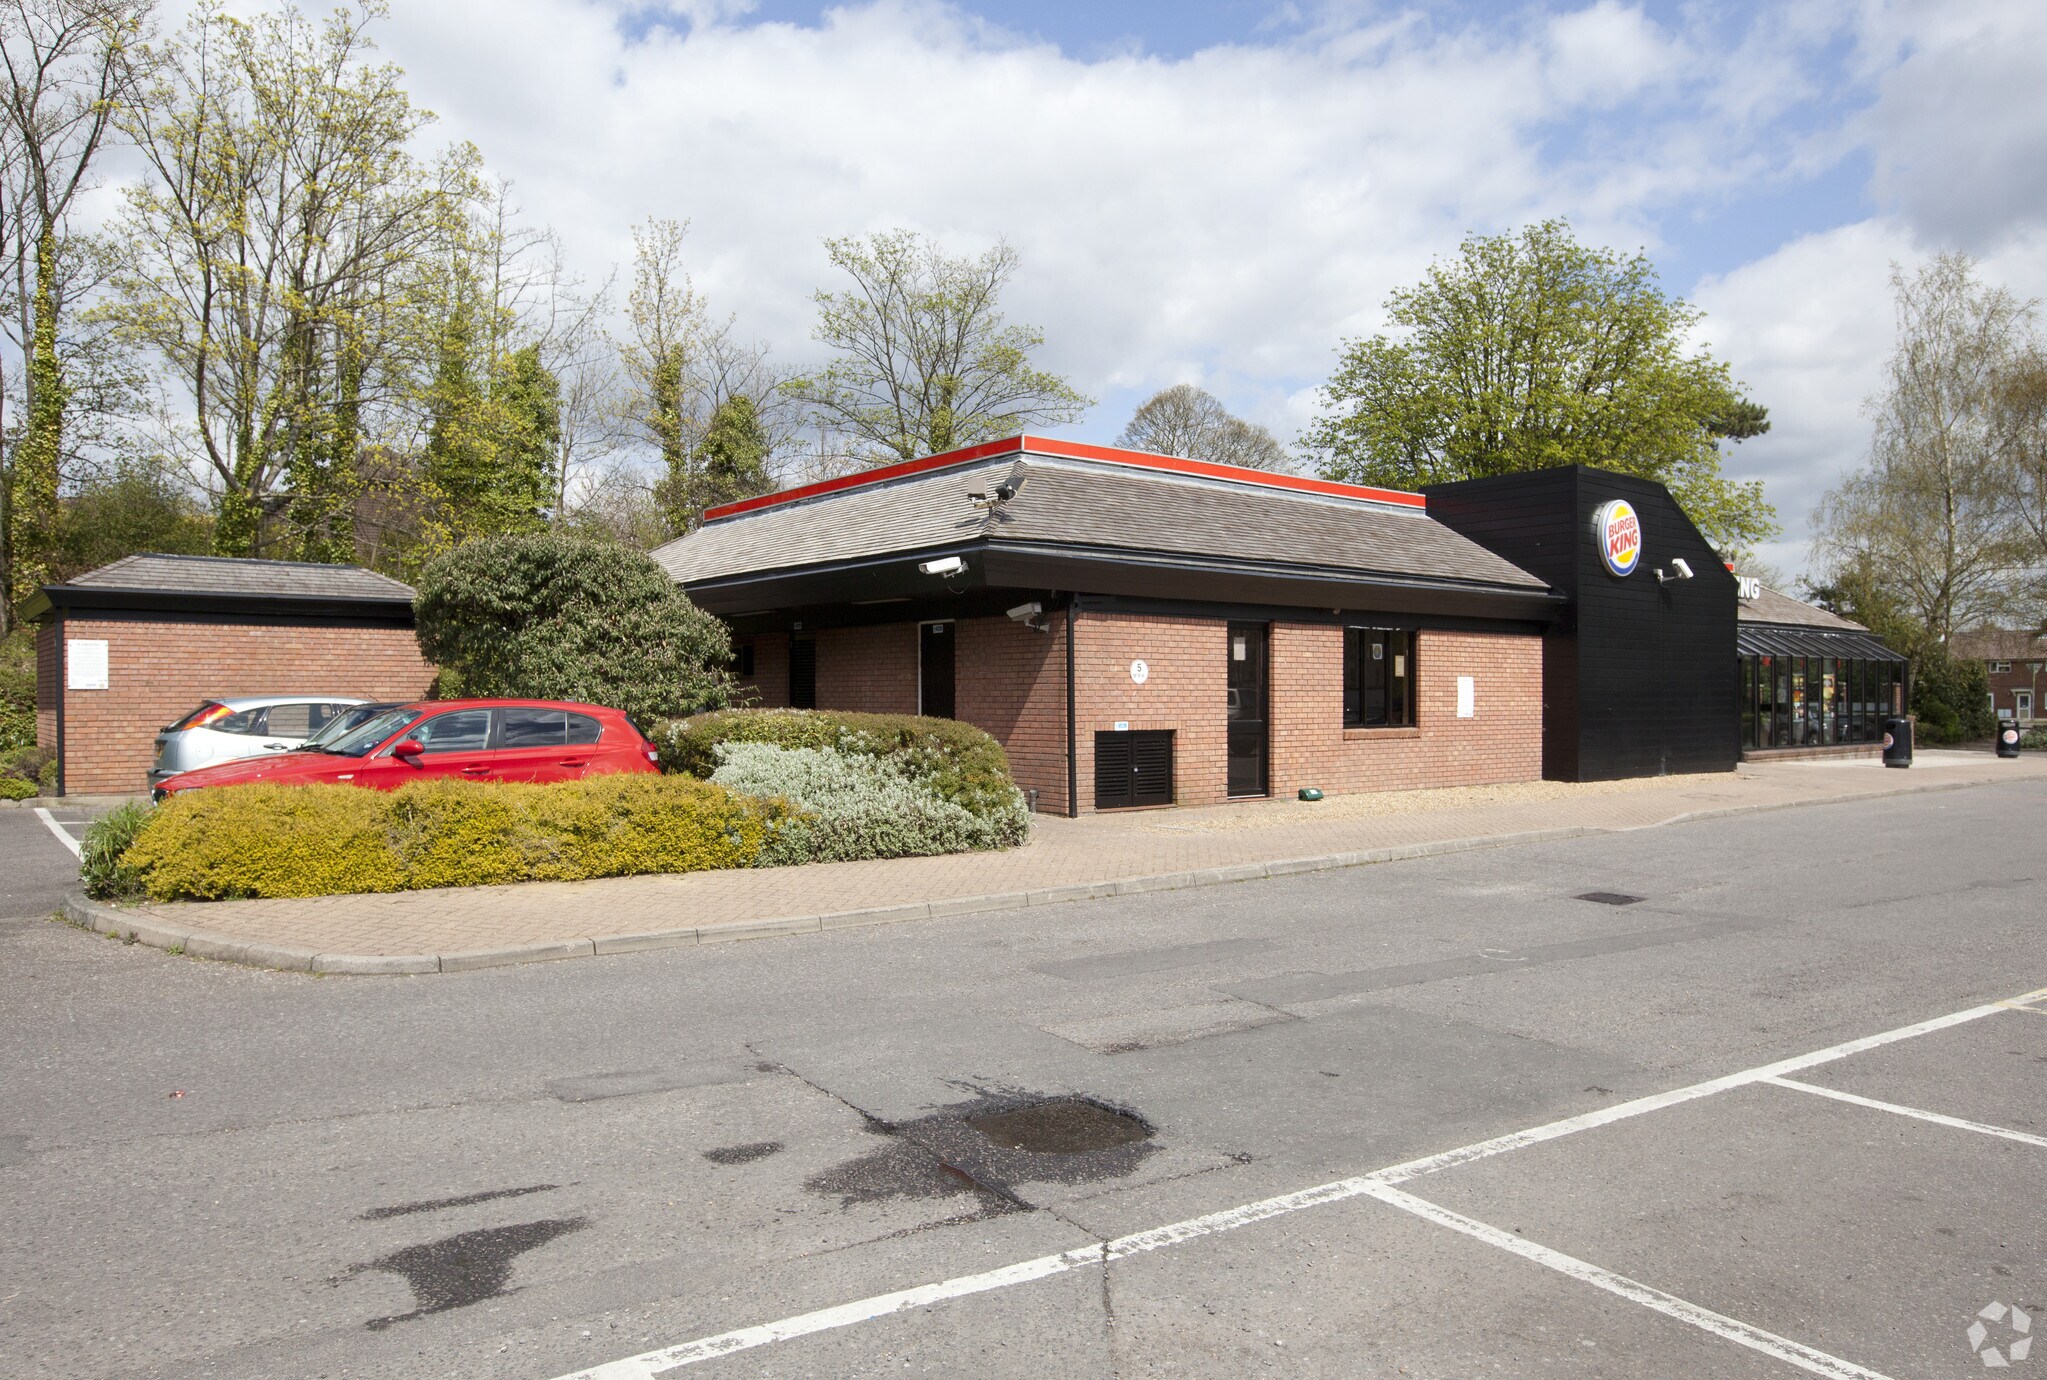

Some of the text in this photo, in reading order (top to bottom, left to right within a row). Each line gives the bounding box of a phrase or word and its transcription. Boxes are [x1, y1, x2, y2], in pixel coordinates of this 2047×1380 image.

[1609, 516, 1636, 539] BURGER
[1609, 529, 1638, 558] KING
[1137, 663, 1142, 672] 5
